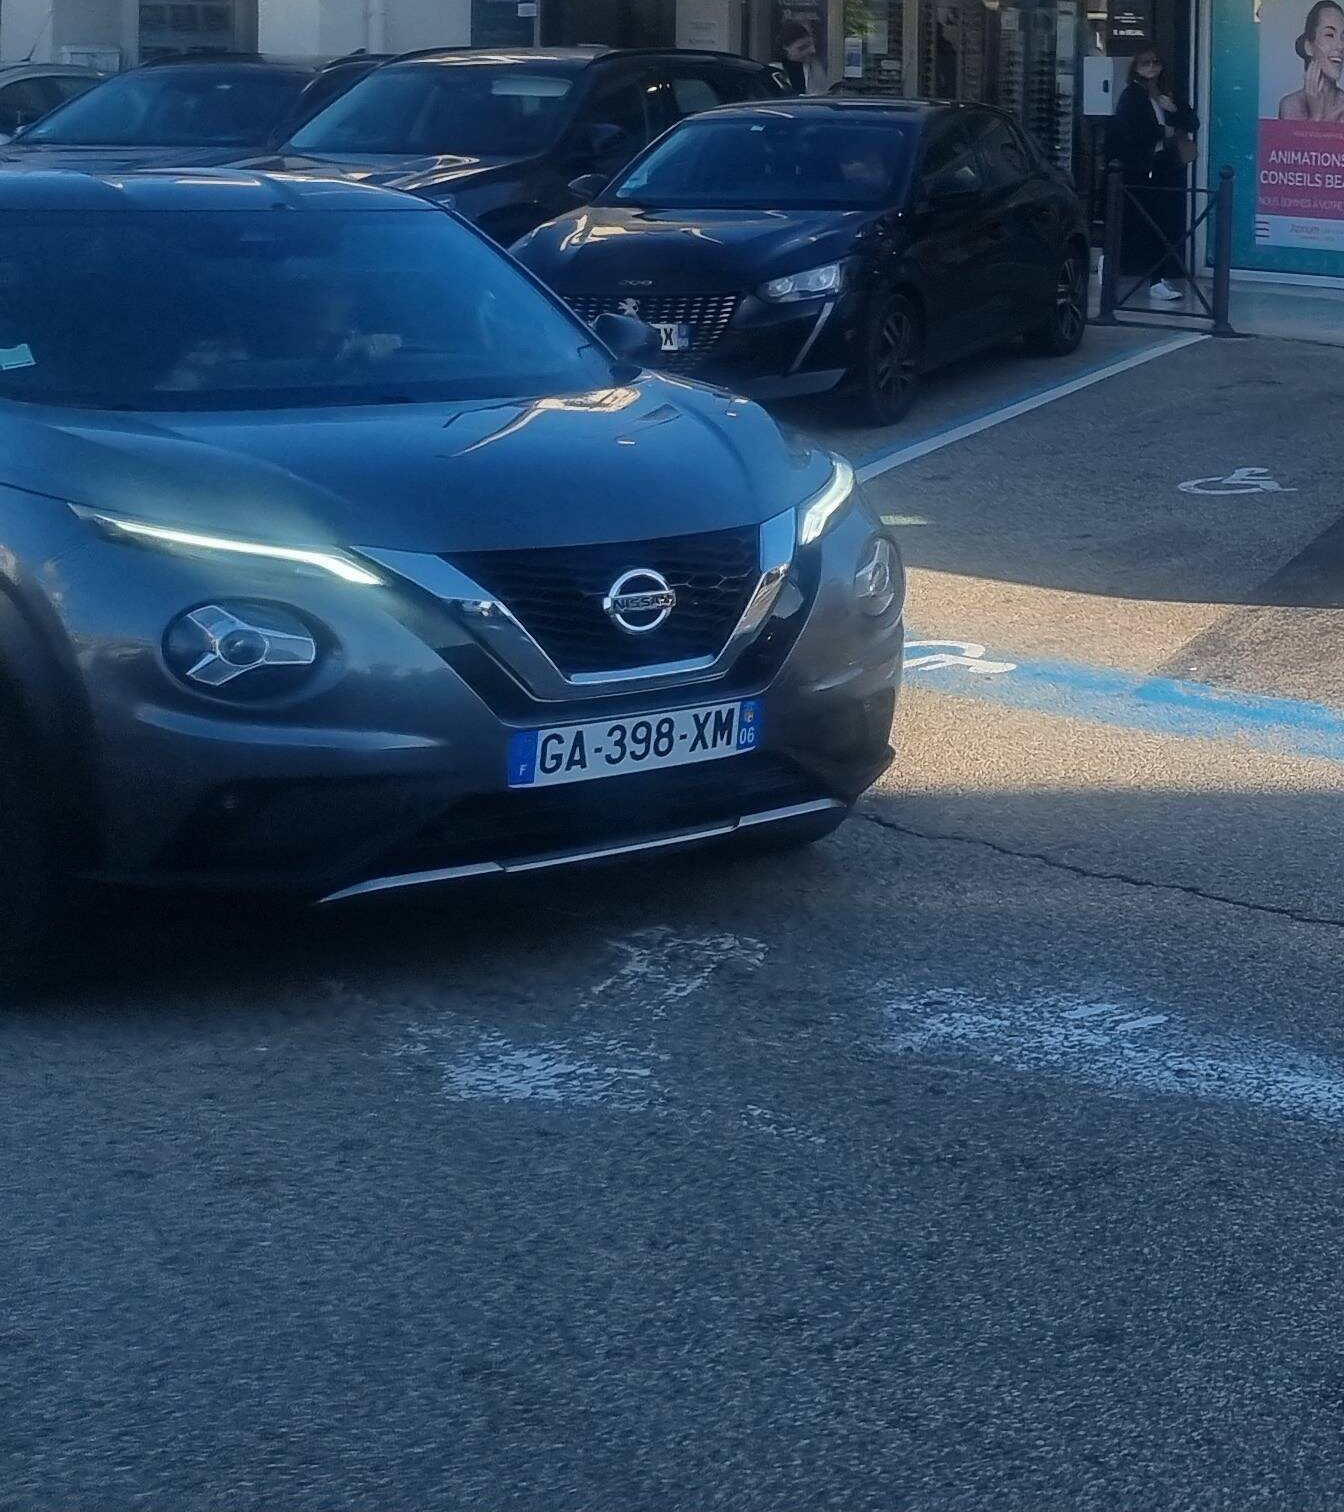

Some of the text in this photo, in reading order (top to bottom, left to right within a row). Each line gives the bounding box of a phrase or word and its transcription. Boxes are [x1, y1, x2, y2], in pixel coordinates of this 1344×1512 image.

[1260, 170, 1322, 187] CONSEILS
[540, 707, 735, 775] GA-398-XM
[739, 727, 756, 746] 06
